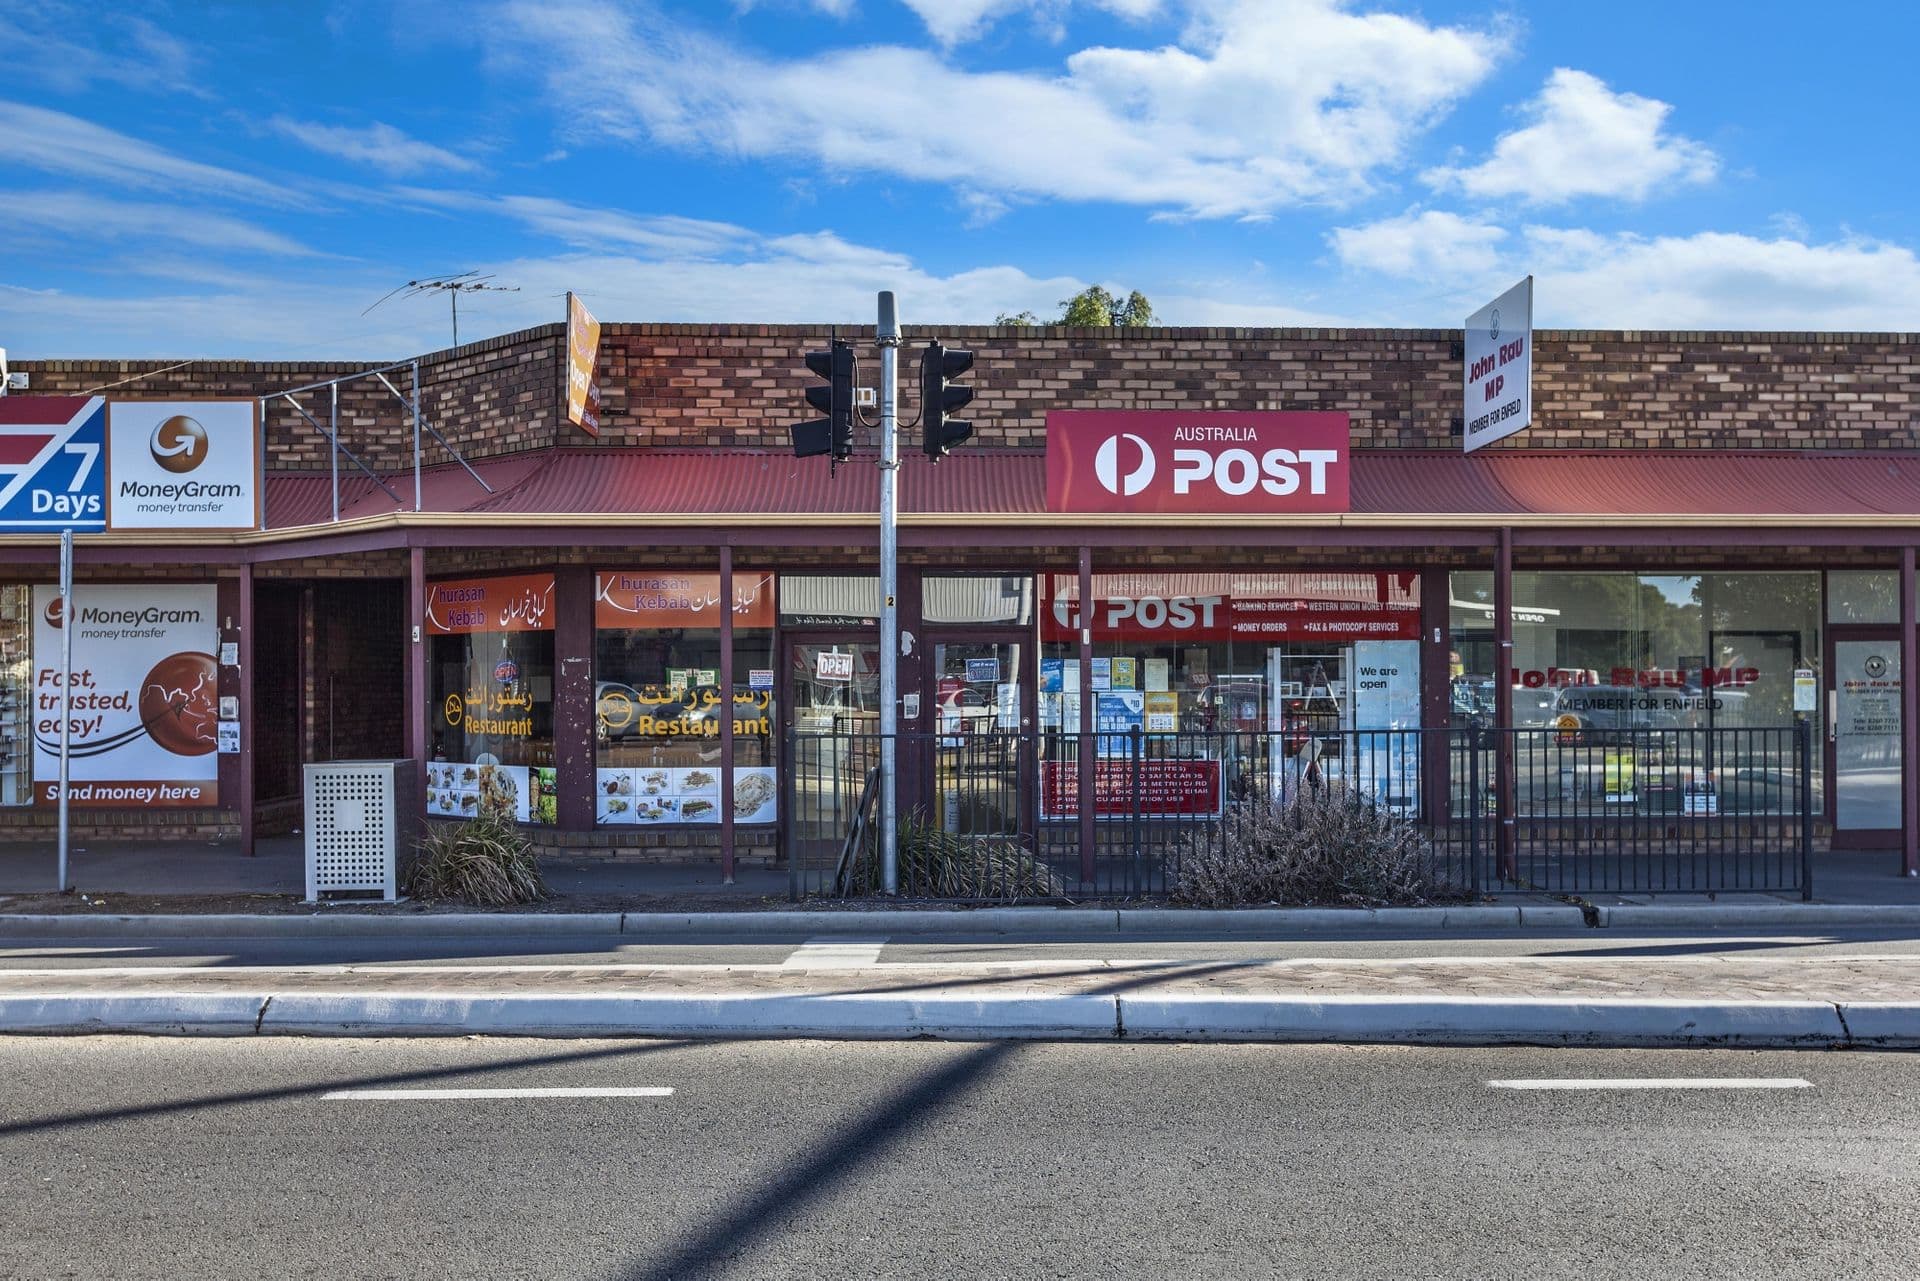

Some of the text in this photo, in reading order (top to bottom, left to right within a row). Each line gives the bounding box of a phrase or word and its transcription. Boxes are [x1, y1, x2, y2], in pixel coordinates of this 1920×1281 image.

[1468, 336, 1523, 384] John Rau
[1485, 374, 1504, 402] MP
[1469, 399, 1521, 435] MEMBER FOR ENFIELD
[1174, 427, 1258, 441] AUSTRALIA
[65, 443, 100, 492] 7
[1174, 448, 1338, 496] POST
[120, 481, 241, 501] MoneyGram
[32, 489, 101, 519] Days
[137, 501, 224, 514] money transfer
[635, 594, 691, 610] Kebab
[887, 597, 895, 606] 2
[1308, 602, 1339, 611] WESTERN
[1340, 602, 1360, 611] UNION
[1361, 602, 1385, 611] MONEY
[81, 607, 200, 627] MoneyGram
[448, 607, 486, 627] Kebab
[1107, 595, 1222, 629] POST
[81, 627, 166, 640] money transfer
[1237, 622, 1288, 632] MONEY ORDERS
[1309, 622, 1399, 632] FAX & PHOTOCOPY SERVICES
[821, 658, 849, 675] OPEN
[1360, 667, 1398, 676] We are
[1360, 679, 1387, 690] open
[1700, 667, 1760, 688] MP
[38, 691, 133, 712] trsted,
[1559, 698, 1724, 710] MEMBER FOR ENFIELD
[465, 715, 533, 736] Restaurant
[639, 715, 769, 735] Restauant
[95, 787, 157, 803] money
[159, 784, 201, 799] here
